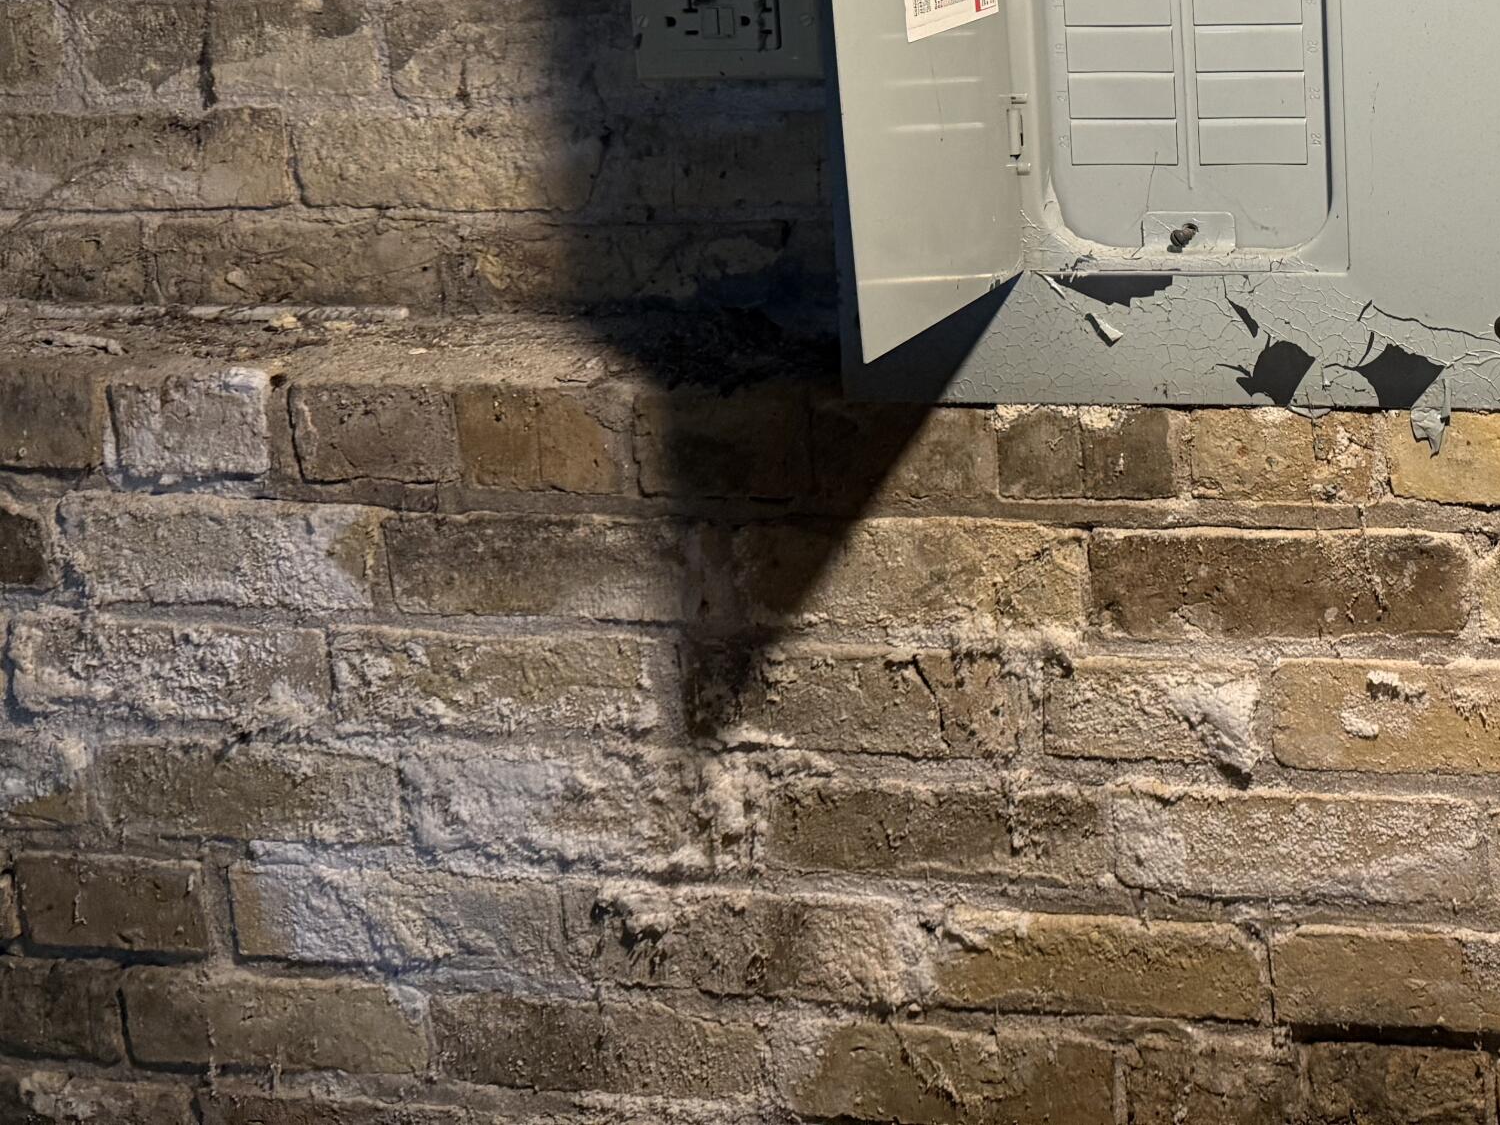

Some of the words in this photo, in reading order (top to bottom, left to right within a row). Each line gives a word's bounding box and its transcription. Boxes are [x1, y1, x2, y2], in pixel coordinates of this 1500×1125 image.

[1308, 40, 1320, 54] 20
[1309, 87, 1320, 100] 22
[1059, 135, 1070, 149] 23
[1311, 132, 1322, 147] 24
